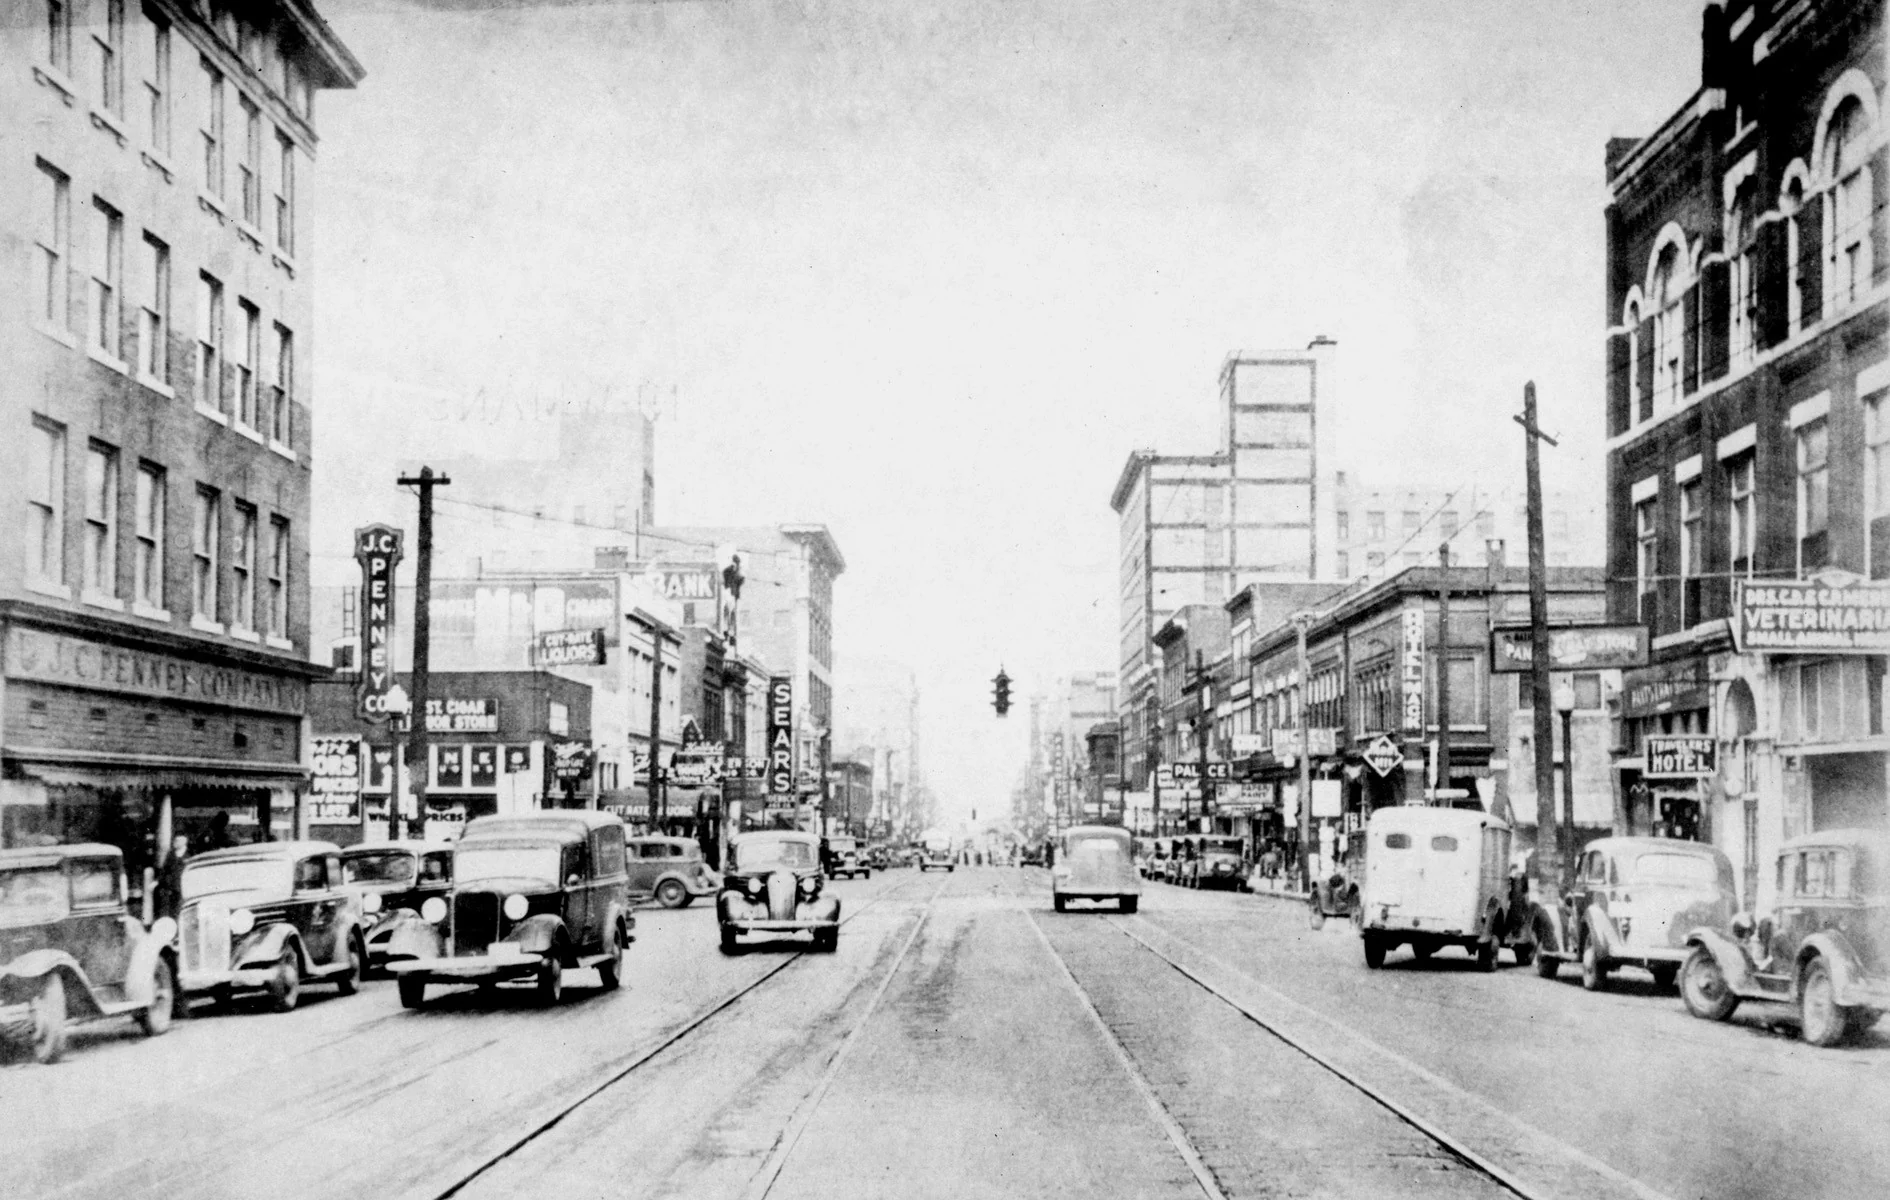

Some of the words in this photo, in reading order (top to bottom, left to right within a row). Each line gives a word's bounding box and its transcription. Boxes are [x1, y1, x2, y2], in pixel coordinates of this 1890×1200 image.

[363, 535, 396, 553] J.C.
[371, 558, 386, 690] PENNEY
[773, 683, 791, 794] SEARS
[1175, 764, 1226, 777] PALCE
[1653, 753, 1709, 772] HOTEL
